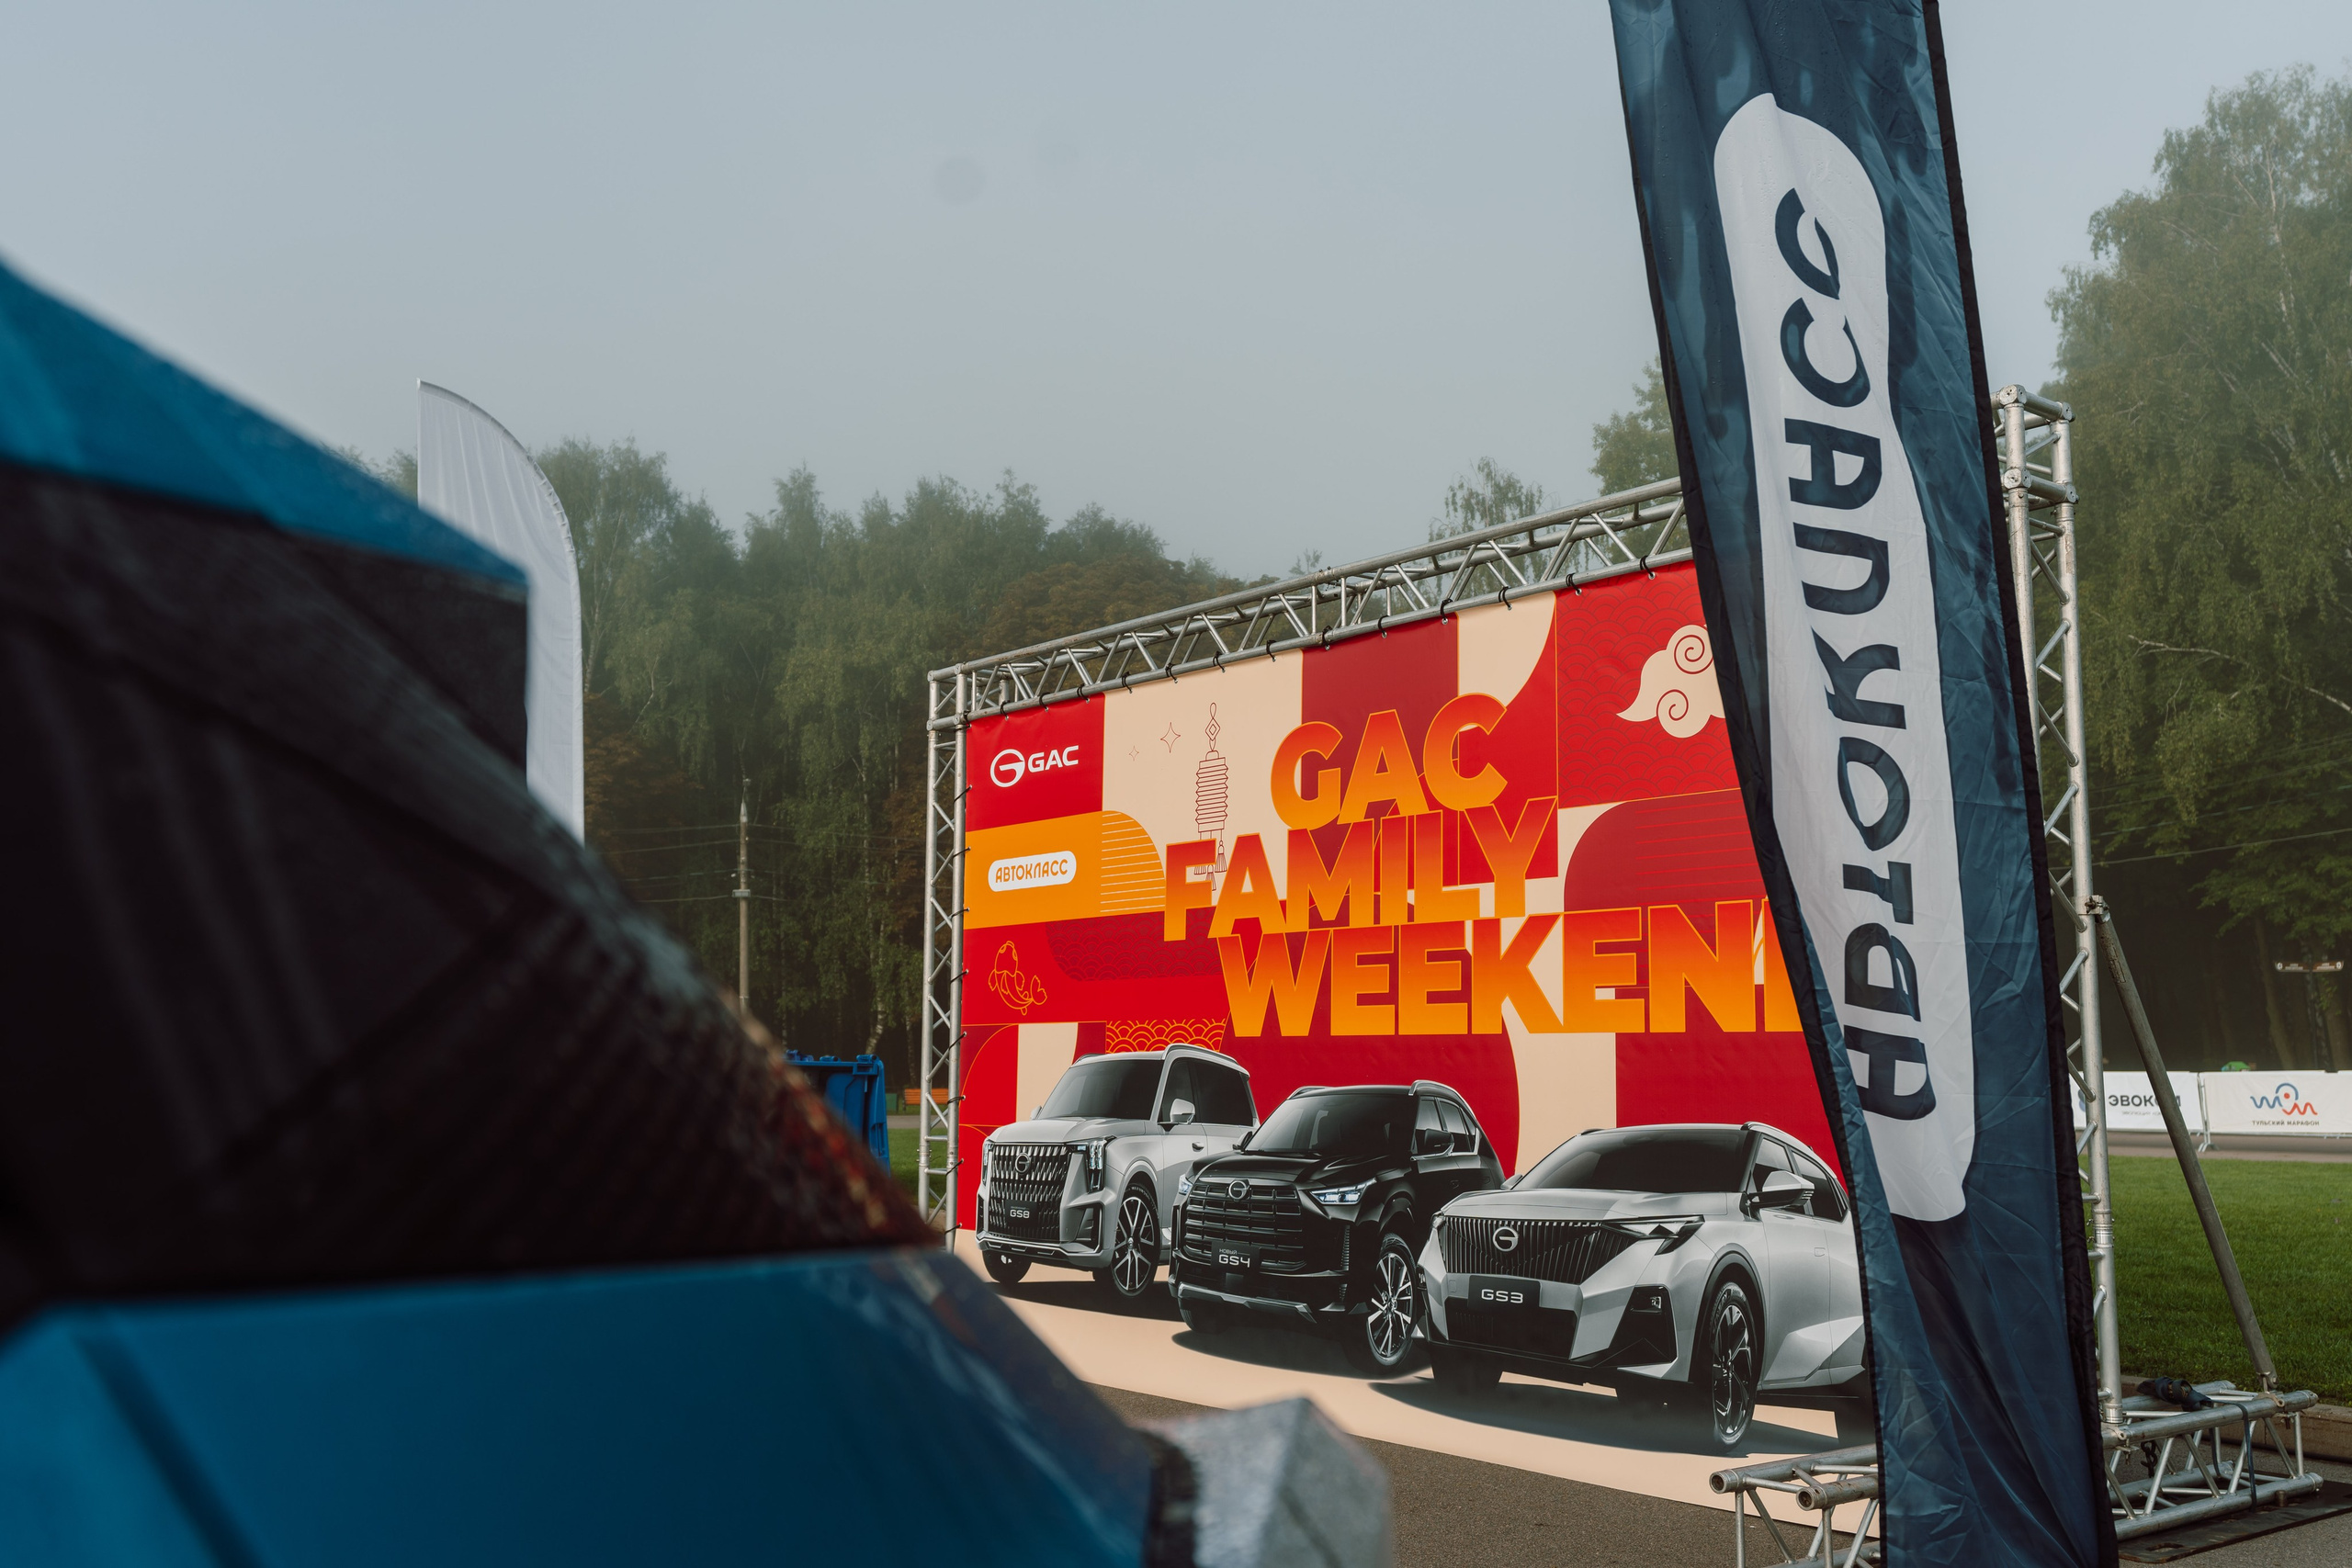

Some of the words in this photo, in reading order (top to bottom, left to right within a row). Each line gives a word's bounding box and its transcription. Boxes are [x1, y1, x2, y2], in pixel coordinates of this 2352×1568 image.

[1027, 745, 1080, 773] GAC
[1271, 693, 1508, 830] GAC
[995, 859, 1069, 884] АВТОКЛАСС
[1163, 795, 1558, 941] FAMILY
[2108, 1094, 2181, 1107] ЭВОК
[1010, 1209, 1030, 1219] GS8
[1218, 1254, 1250, 1268] GS4
[1481, 1289, 1523, 1303] GS3
